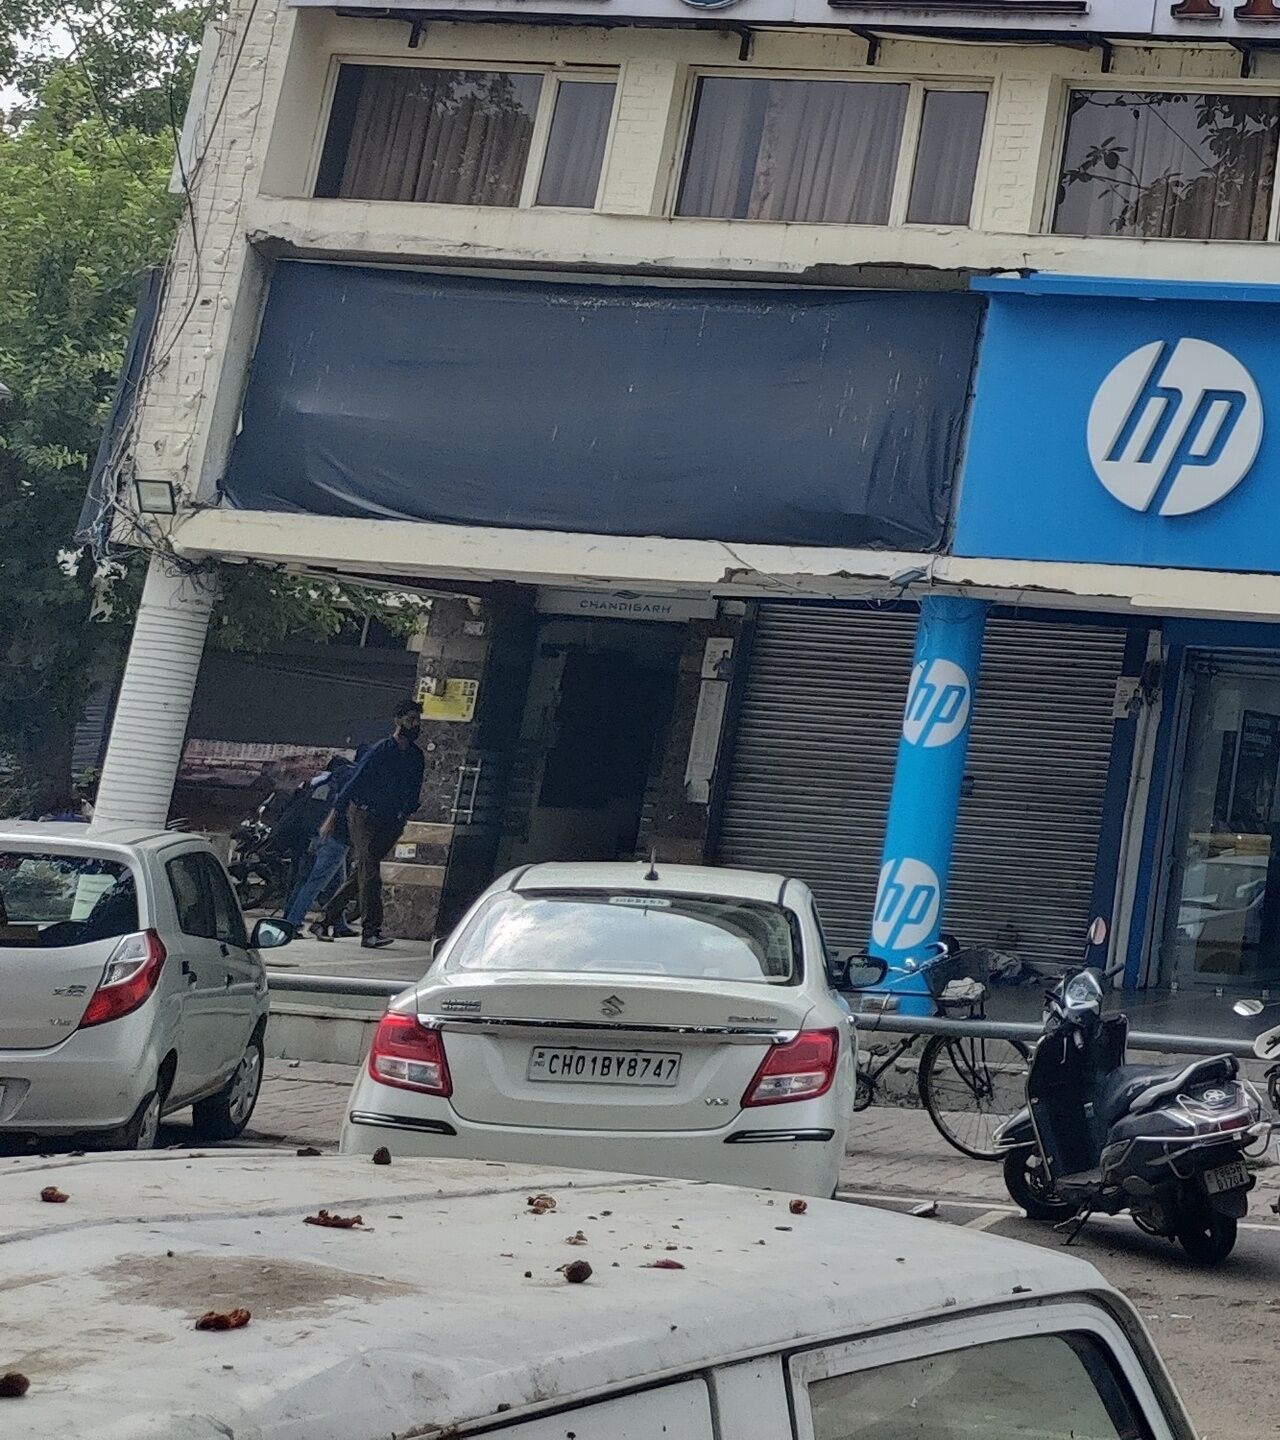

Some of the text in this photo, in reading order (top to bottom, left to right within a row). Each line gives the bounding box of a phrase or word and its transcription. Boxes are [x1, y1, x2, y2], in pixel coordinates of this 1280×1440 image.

[1087, 338, 1263, 516] hp
[580, 599, 673, 614] CHANDIGARH
[903, 658, 970, 748] hp
[872, 857, 940, 950] hp
[548, 1053, 677, 1080] CH01BY8747
